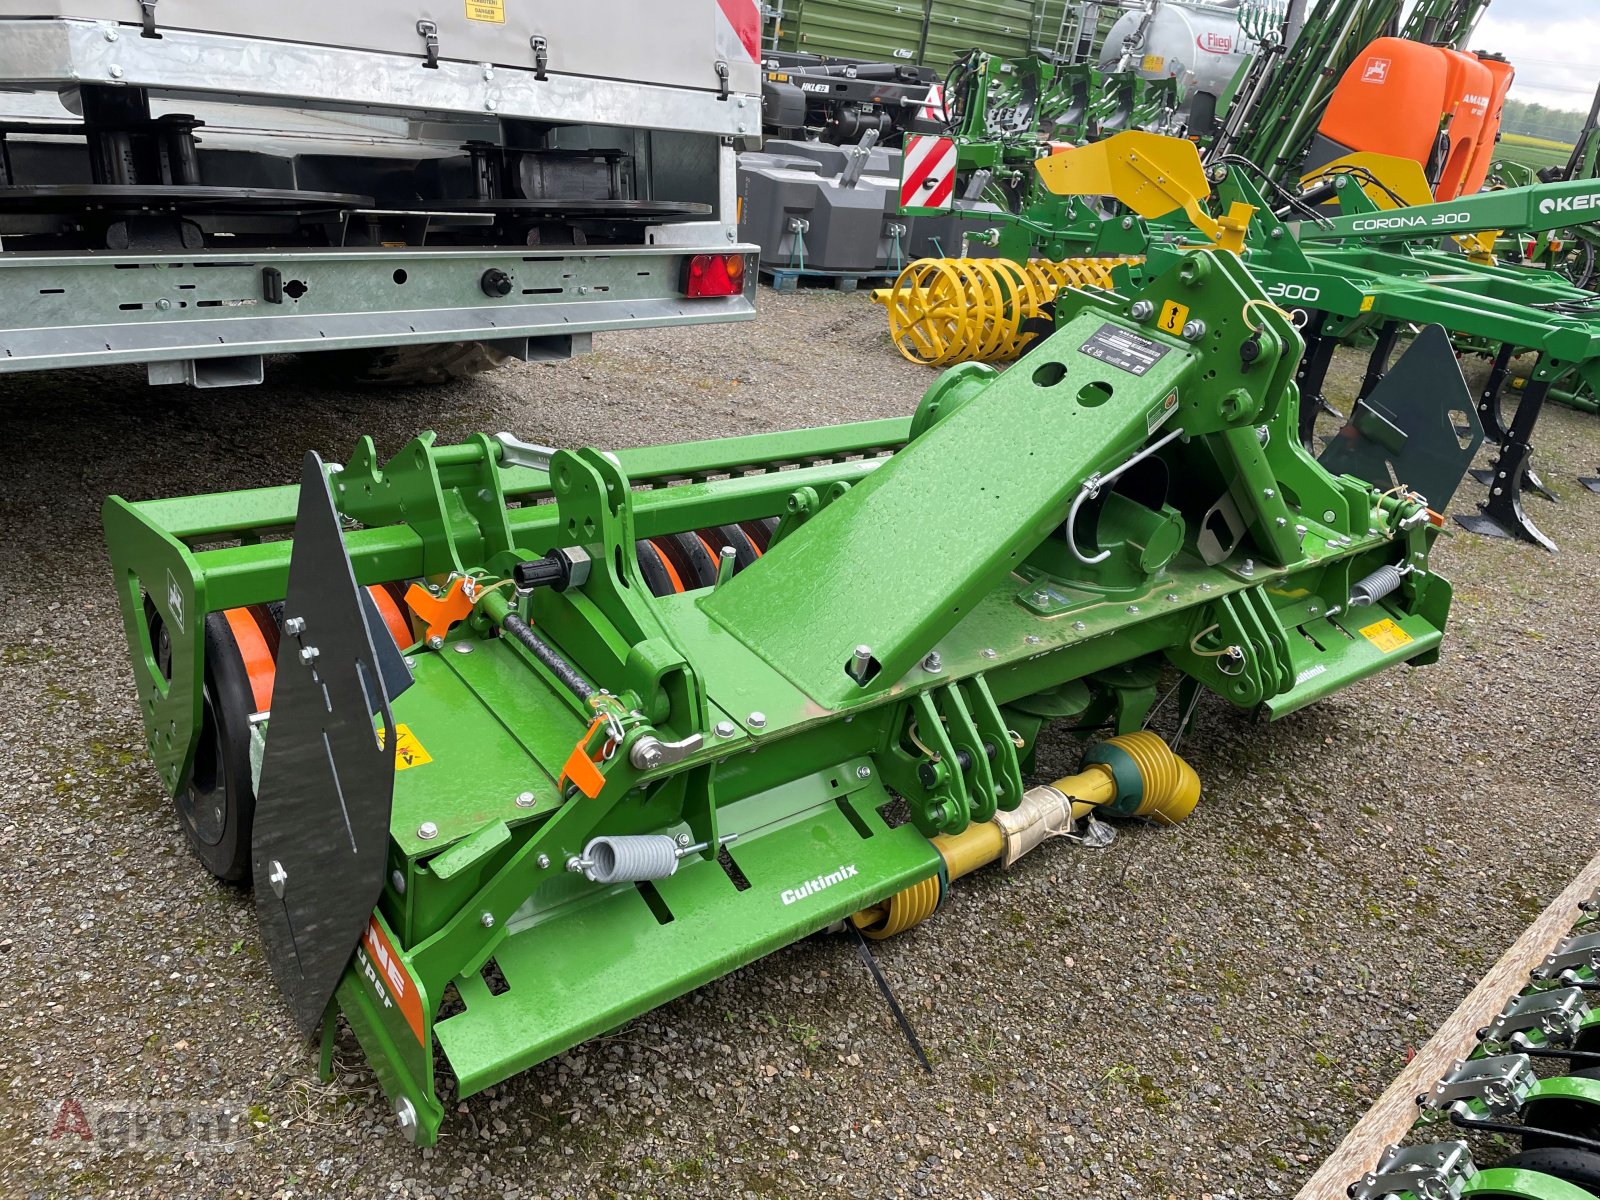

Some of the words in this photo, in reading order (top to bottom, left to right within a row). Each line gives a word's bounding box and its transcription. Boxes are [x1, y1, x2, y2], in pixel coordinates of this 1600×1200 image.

[1208, 32, 1232, 51] Fliegl
[1352, 215, 1428, 231] CORONA
[1431, 212, 1471, 225] 300
[1267, 282, 1320, 302] 300
[781, 864, 859, 906] Cultimix
[368, 923, 405, 998] NE
[357, 945, 393, 1008] uper
